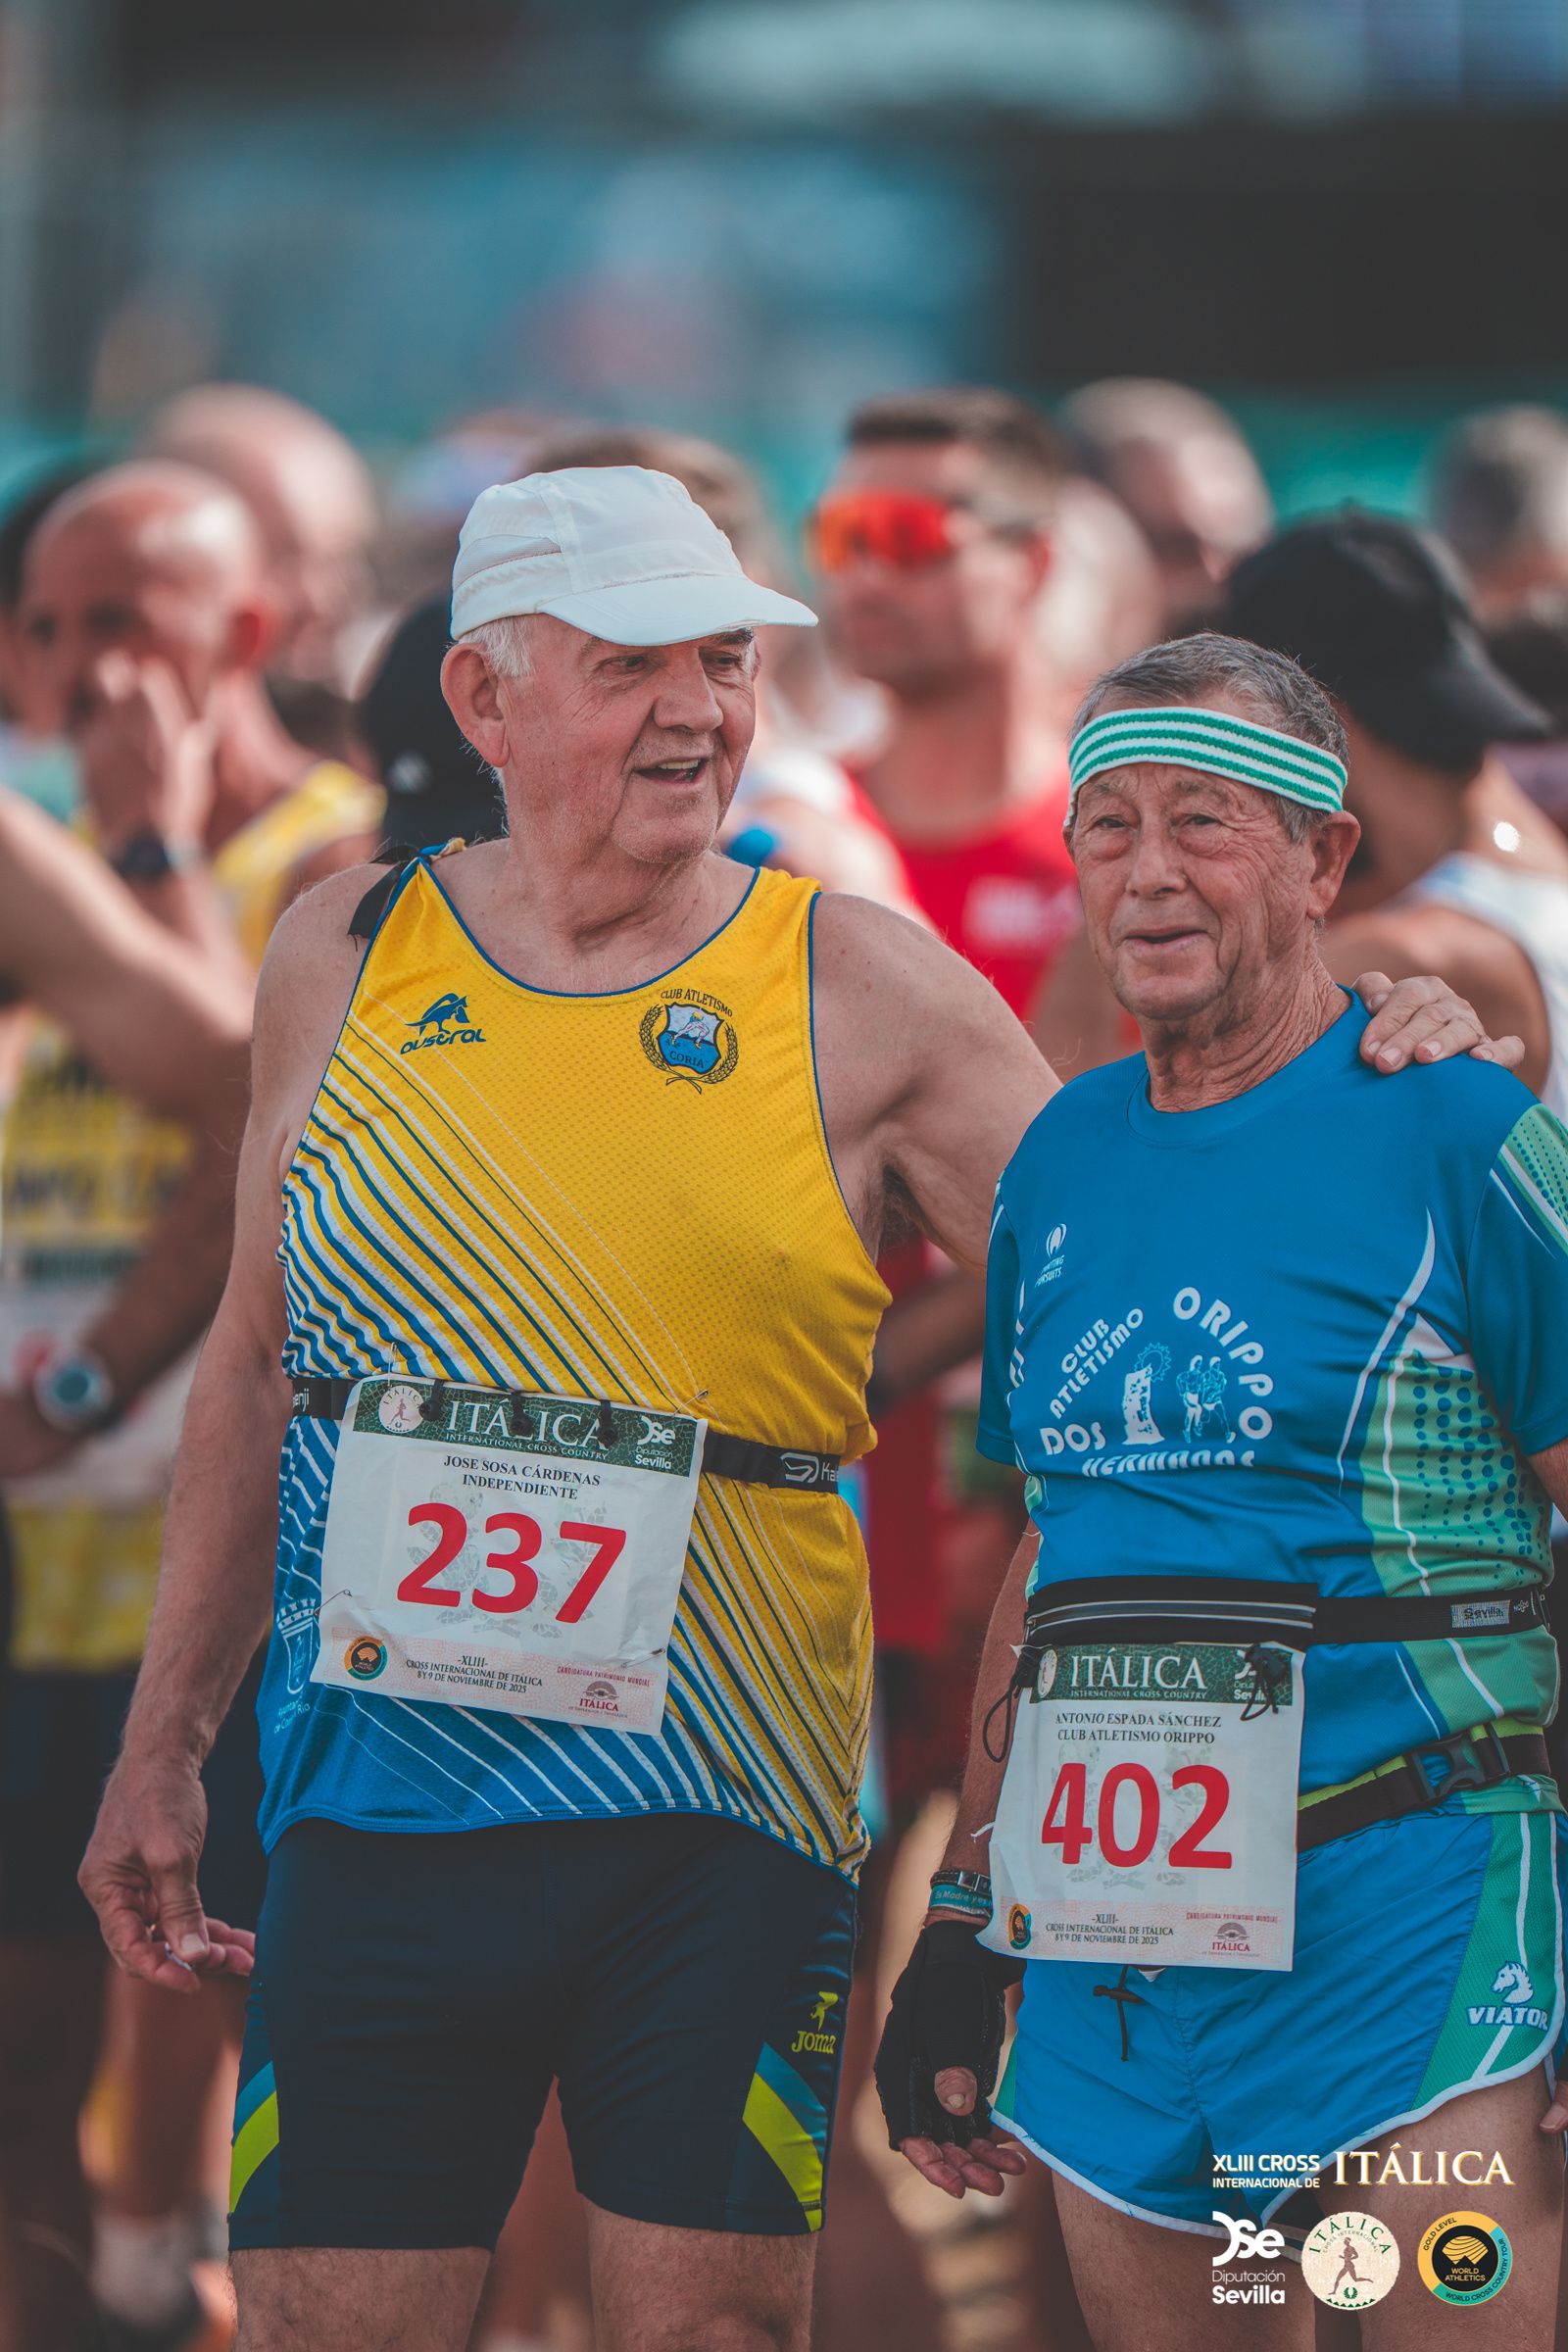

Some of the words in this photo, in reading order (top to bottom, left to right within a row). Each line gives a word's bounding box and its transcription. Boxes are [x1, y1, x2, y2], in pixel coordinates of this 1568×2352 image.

[661, 989, 683, 1000] CLUB
[683, 988, 733, 1017] ATLETISMO
[669, 1051, 705, 1069] CORIA
[1060, 1317, 1110, 1374] CLUB
[1049, 1308, 1145, 1420] ATLETISMO
[1172, 1286, 1274, 1441] ORIPPO
[446, 1433, 524, 1450] INTERNATIONAL
[527, 1443, 558, 1453] CROSS
[561, 1447, 609, 1460] COUNTRY
[1039, 1421, 1106, 1456] DOS
[444, 1455, 479, 1470] JOSE
[481, 1460, 517, 1476] SOSA
[521, 1465, 601, 1487] CÁRDENAS
[635, 1454, 672, 1470] Sevilla
[821, 1461, 838, 1482] Ka
[463, 1474, 578, 1500] INDEPENDIENTE
[397, 1502, 626, 1624] 237
[406, 1659, 429, 1670] CROSS
[430, 1662, 496, 1680] INTERNACIONAL
[498, 1672, 510, 1682] DE
[511, 1673, 543, 1687] ITÁLICA
[595, 1671, 626, 1683] PATRIMONIO
[1070, 1646, 1207, 1690] ITÁLICA
[434, 1672, 446, 1682] DE
[447, 1675, 494, 1689] NOVIEMBRE
[496, 1683, 508, 1691] DE
[509, 1683, 527, 1693] 2025
[1070, 1690, 1130, 1698] INTERNATIONAL
[1163, 1690, 1207, 1700] COUNTRY
[579, 1696, 619, 1712] ITÁLICA
[1055, 1712, 1104, 1725] ANTONIO
[1106, 1713, 1154, 1726] ESPADA
[1157, 1711, 1222, 1728] SÁNCHEZ
[1057, 1729, 1086, 1741] CLUB
[1089, 1730, 1160, 1742] ATLETISMO
[1163, 1731, 1215, 1744] ORIPPO
[1041, 1762, 1233, 1869] 402
[1046, 1923, 1065, 1933] CROSS
[1066, 1924, 1127, 1935] INTERNACIONAL
[1129, 1926, 1141, 1936] DE
[1142, 1925, 1174, 1936] ITÁLICA
[1071, 1934, 1082, 1942] DE
[1083, 1935, 1127, 1943] NOVIEMBRE
[1129, 1936, 1140, 1944] DE
[1141, 1936, 1159, 1945] 2025
[1211, 1940, 1250, 1952] ITÁLICA
[1467, 2006, 1548, 2032] VIATOR
